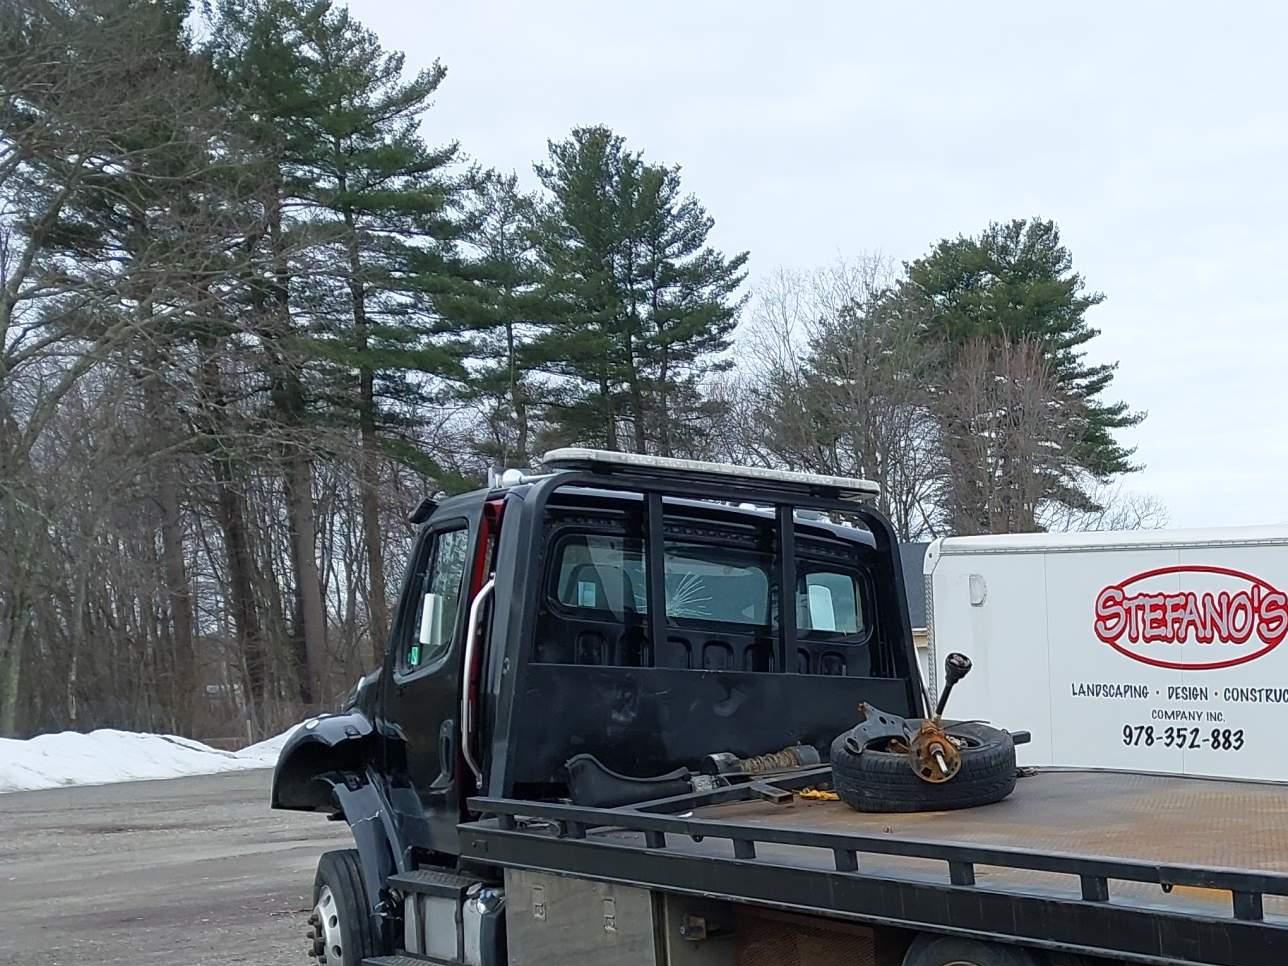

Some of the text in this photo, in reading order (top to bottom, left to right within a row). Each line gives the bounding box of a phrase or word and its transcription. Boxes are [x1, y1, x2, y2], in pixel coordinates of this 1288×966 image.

[1071, 683, 1150, 699] LANDSCAPING
[1167, 686, 1208, 701] DESIGN
[1151, 709, 1226, 722] COMPANY INC.
[1122, 724, 1245, 751] 978-352-883
